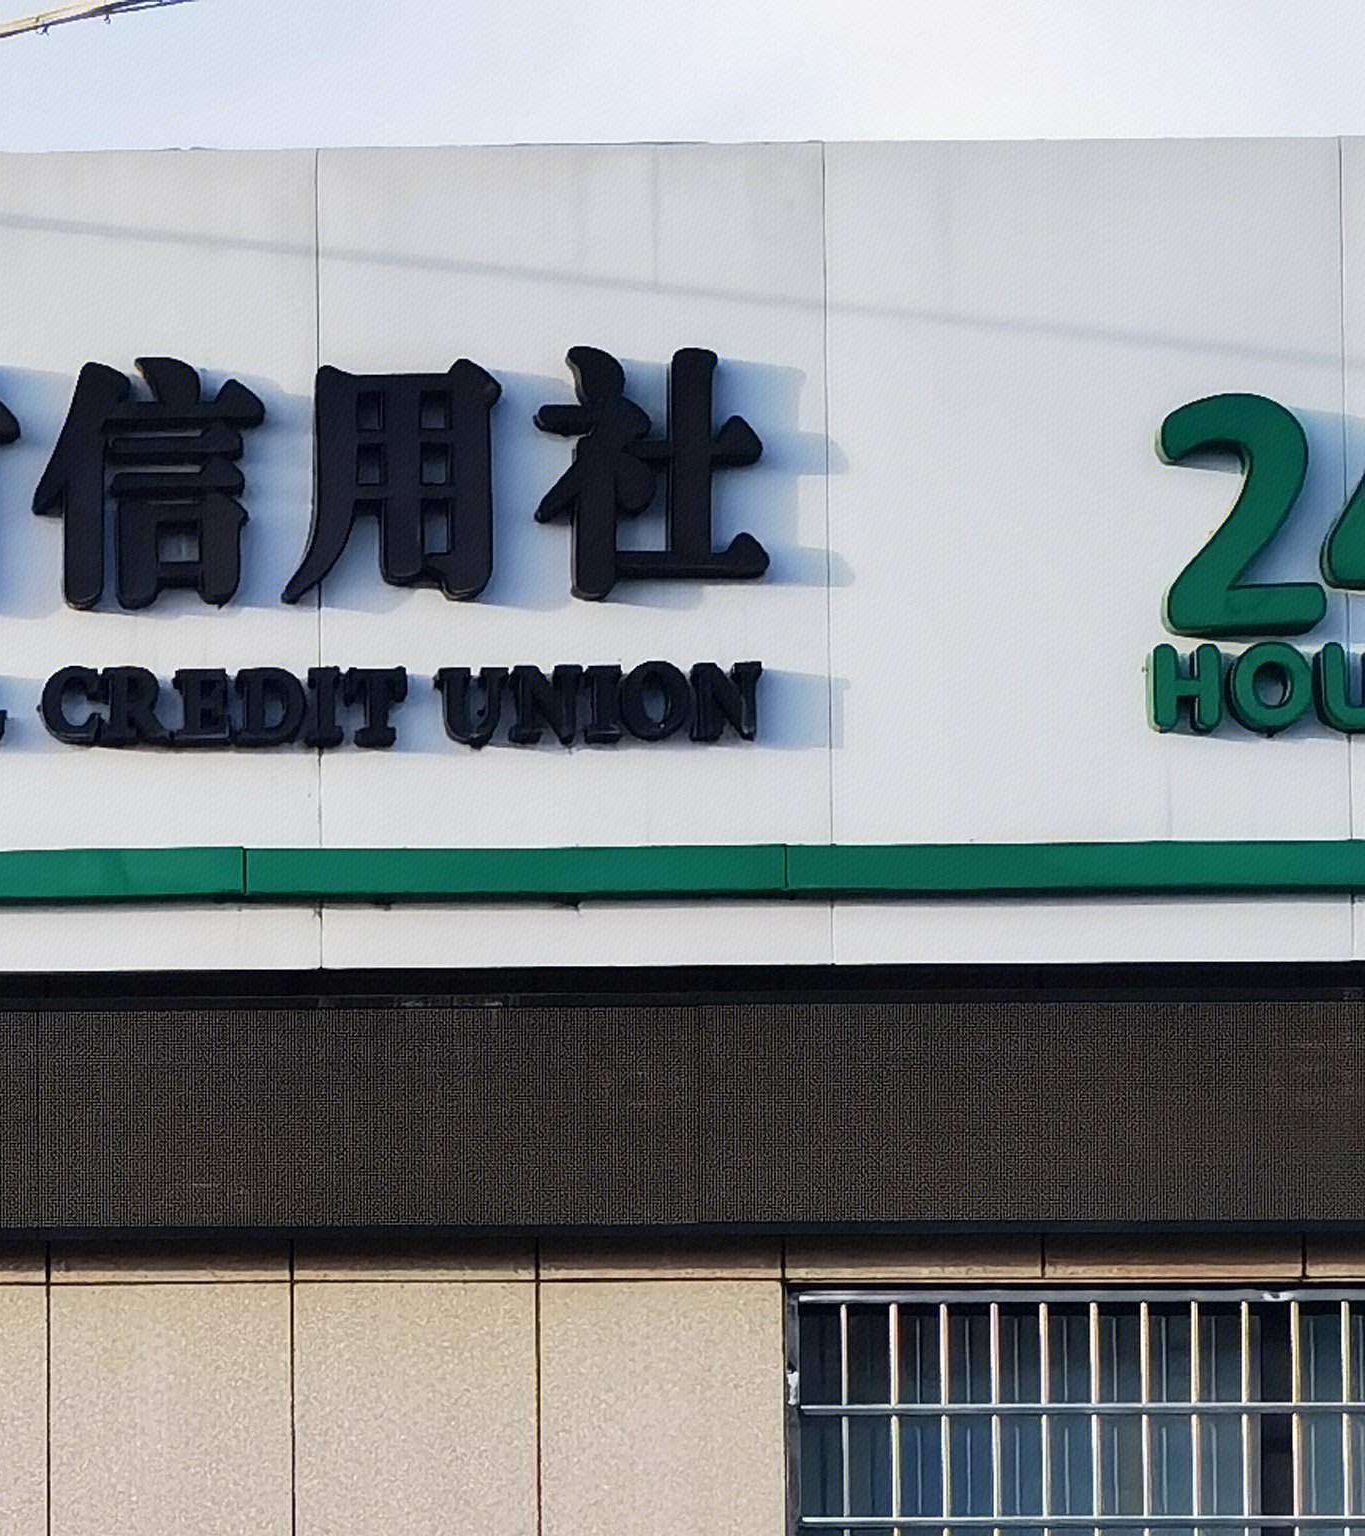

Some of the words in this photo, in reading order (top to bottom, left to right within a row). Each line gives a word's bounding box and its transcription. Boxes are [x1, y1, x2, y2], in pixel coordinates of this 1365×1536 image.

[1160, 392, 1365, 637] 2
[37, 665, 408, 748] CREDIT
[434, 661, 762, 745] UNION
